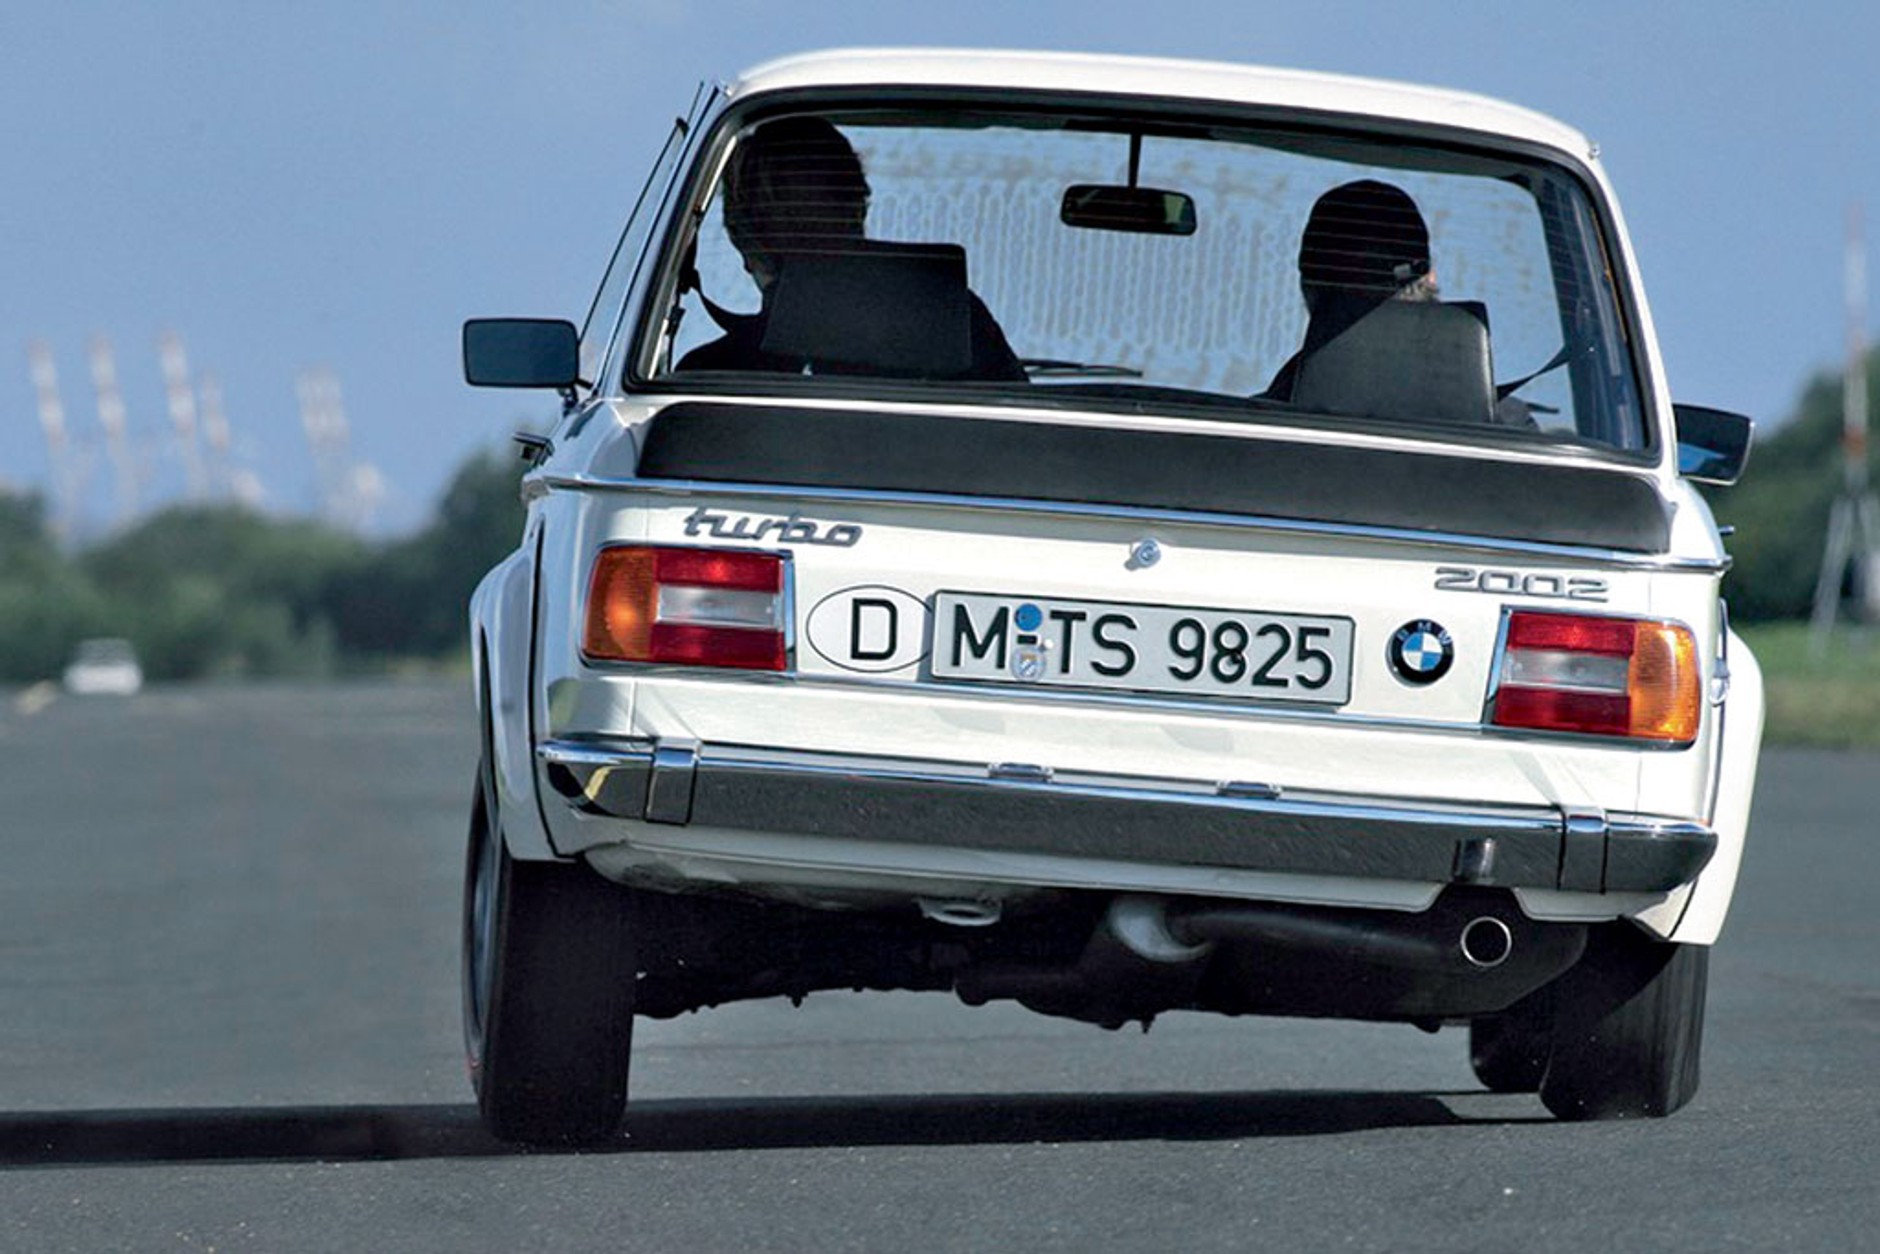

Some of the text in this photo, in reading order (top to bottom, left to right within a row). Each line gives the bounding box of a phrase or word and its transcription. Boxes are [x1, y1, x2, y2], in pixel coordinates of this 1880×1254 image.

[684, 508, 862, 547] turbo
[1434, 566, 1609, 603] 2002
[851, 598, 898, 660] D
[1396, 621, 1452, 646] BMW
[1168, 618, 1333, 689] 9825
